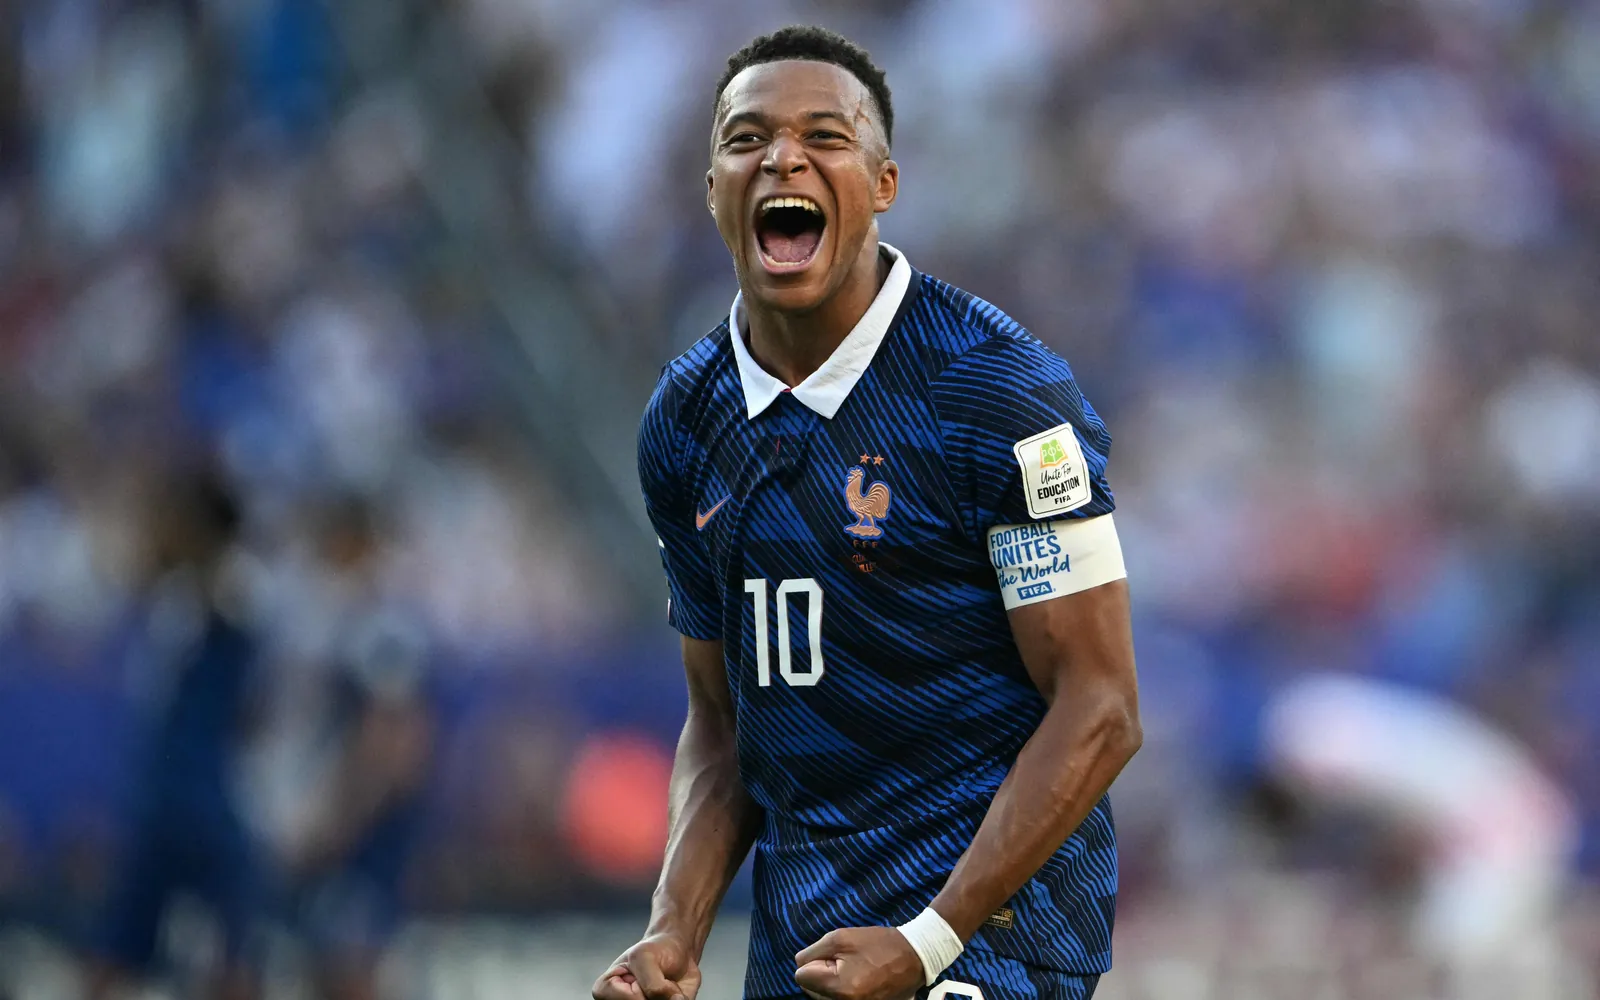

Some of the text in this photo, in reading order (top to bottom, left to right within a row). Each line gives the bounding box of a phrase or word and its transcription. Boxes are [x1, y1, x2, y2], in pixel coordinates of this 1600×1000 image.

[1037, 475, 1080, 499] EDUCATION
[1041, 468, 1061, 485] Unite
[1054, 494, 1071, 504] FIFA
[990, 521, 1056, 549] FOOTBALL
[992, 535, 1061, 569] UNITES
[998, 554, 1071, 588] the World
[1020, 583, 1051, 598] FIFA
[744, 578, 824, 687] 10
